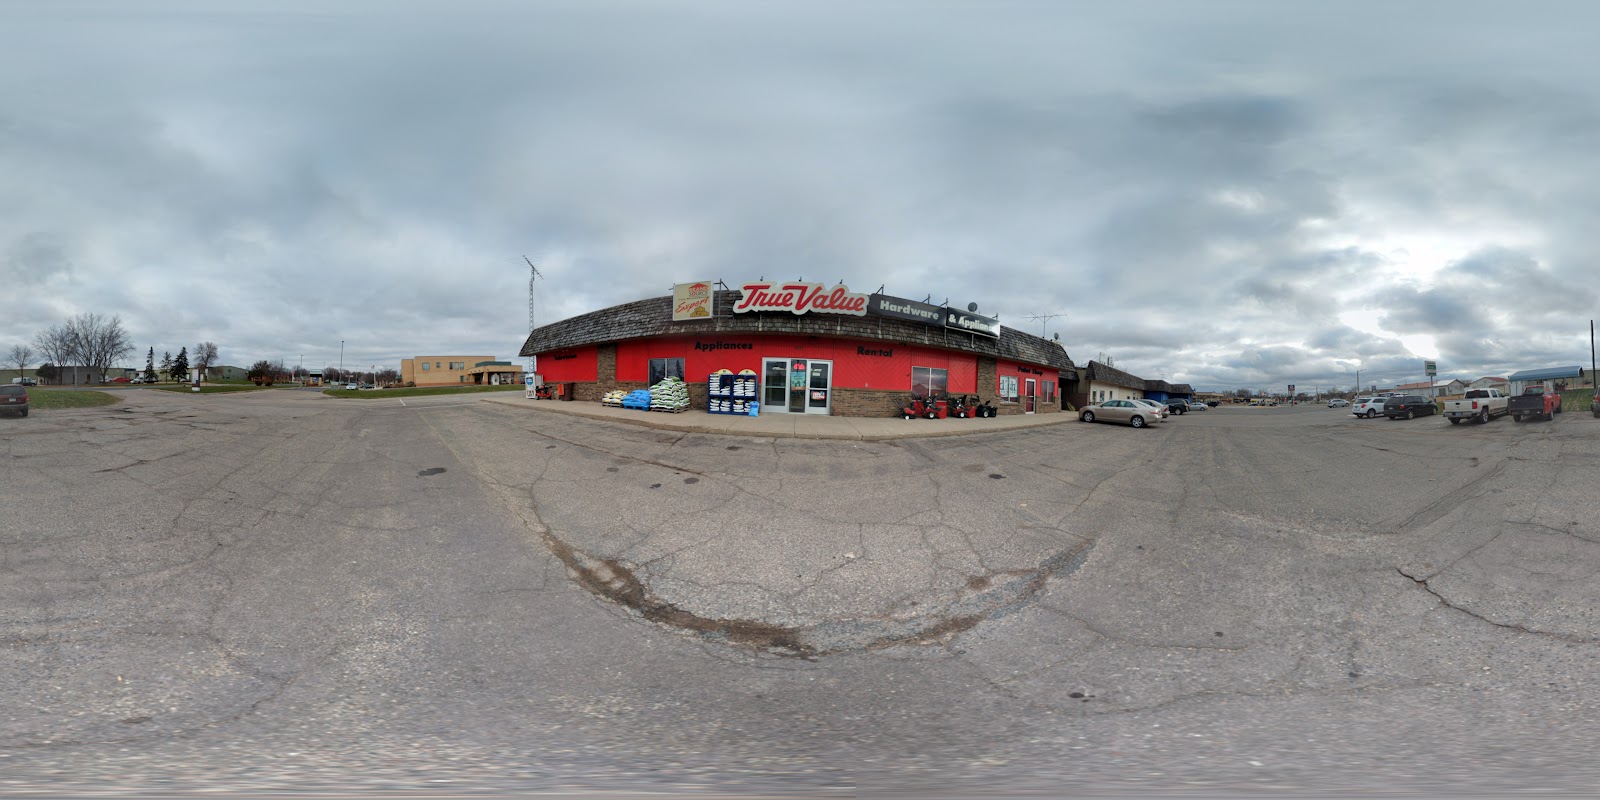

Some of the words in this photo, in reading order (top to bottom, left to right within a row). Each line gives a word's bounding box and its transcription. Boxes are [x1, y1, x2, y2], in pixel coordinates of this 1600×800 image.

[675, 296, 710, 313] Expert
[737, 285, 794, 309] True
[782, 285, 865, 311] Value
[880, 300, 939, 320] Hardware
[949, 313, 957, 324] &
[694, 341, 753, 352] Appliances
[857, 345, 893, 357] Rental
